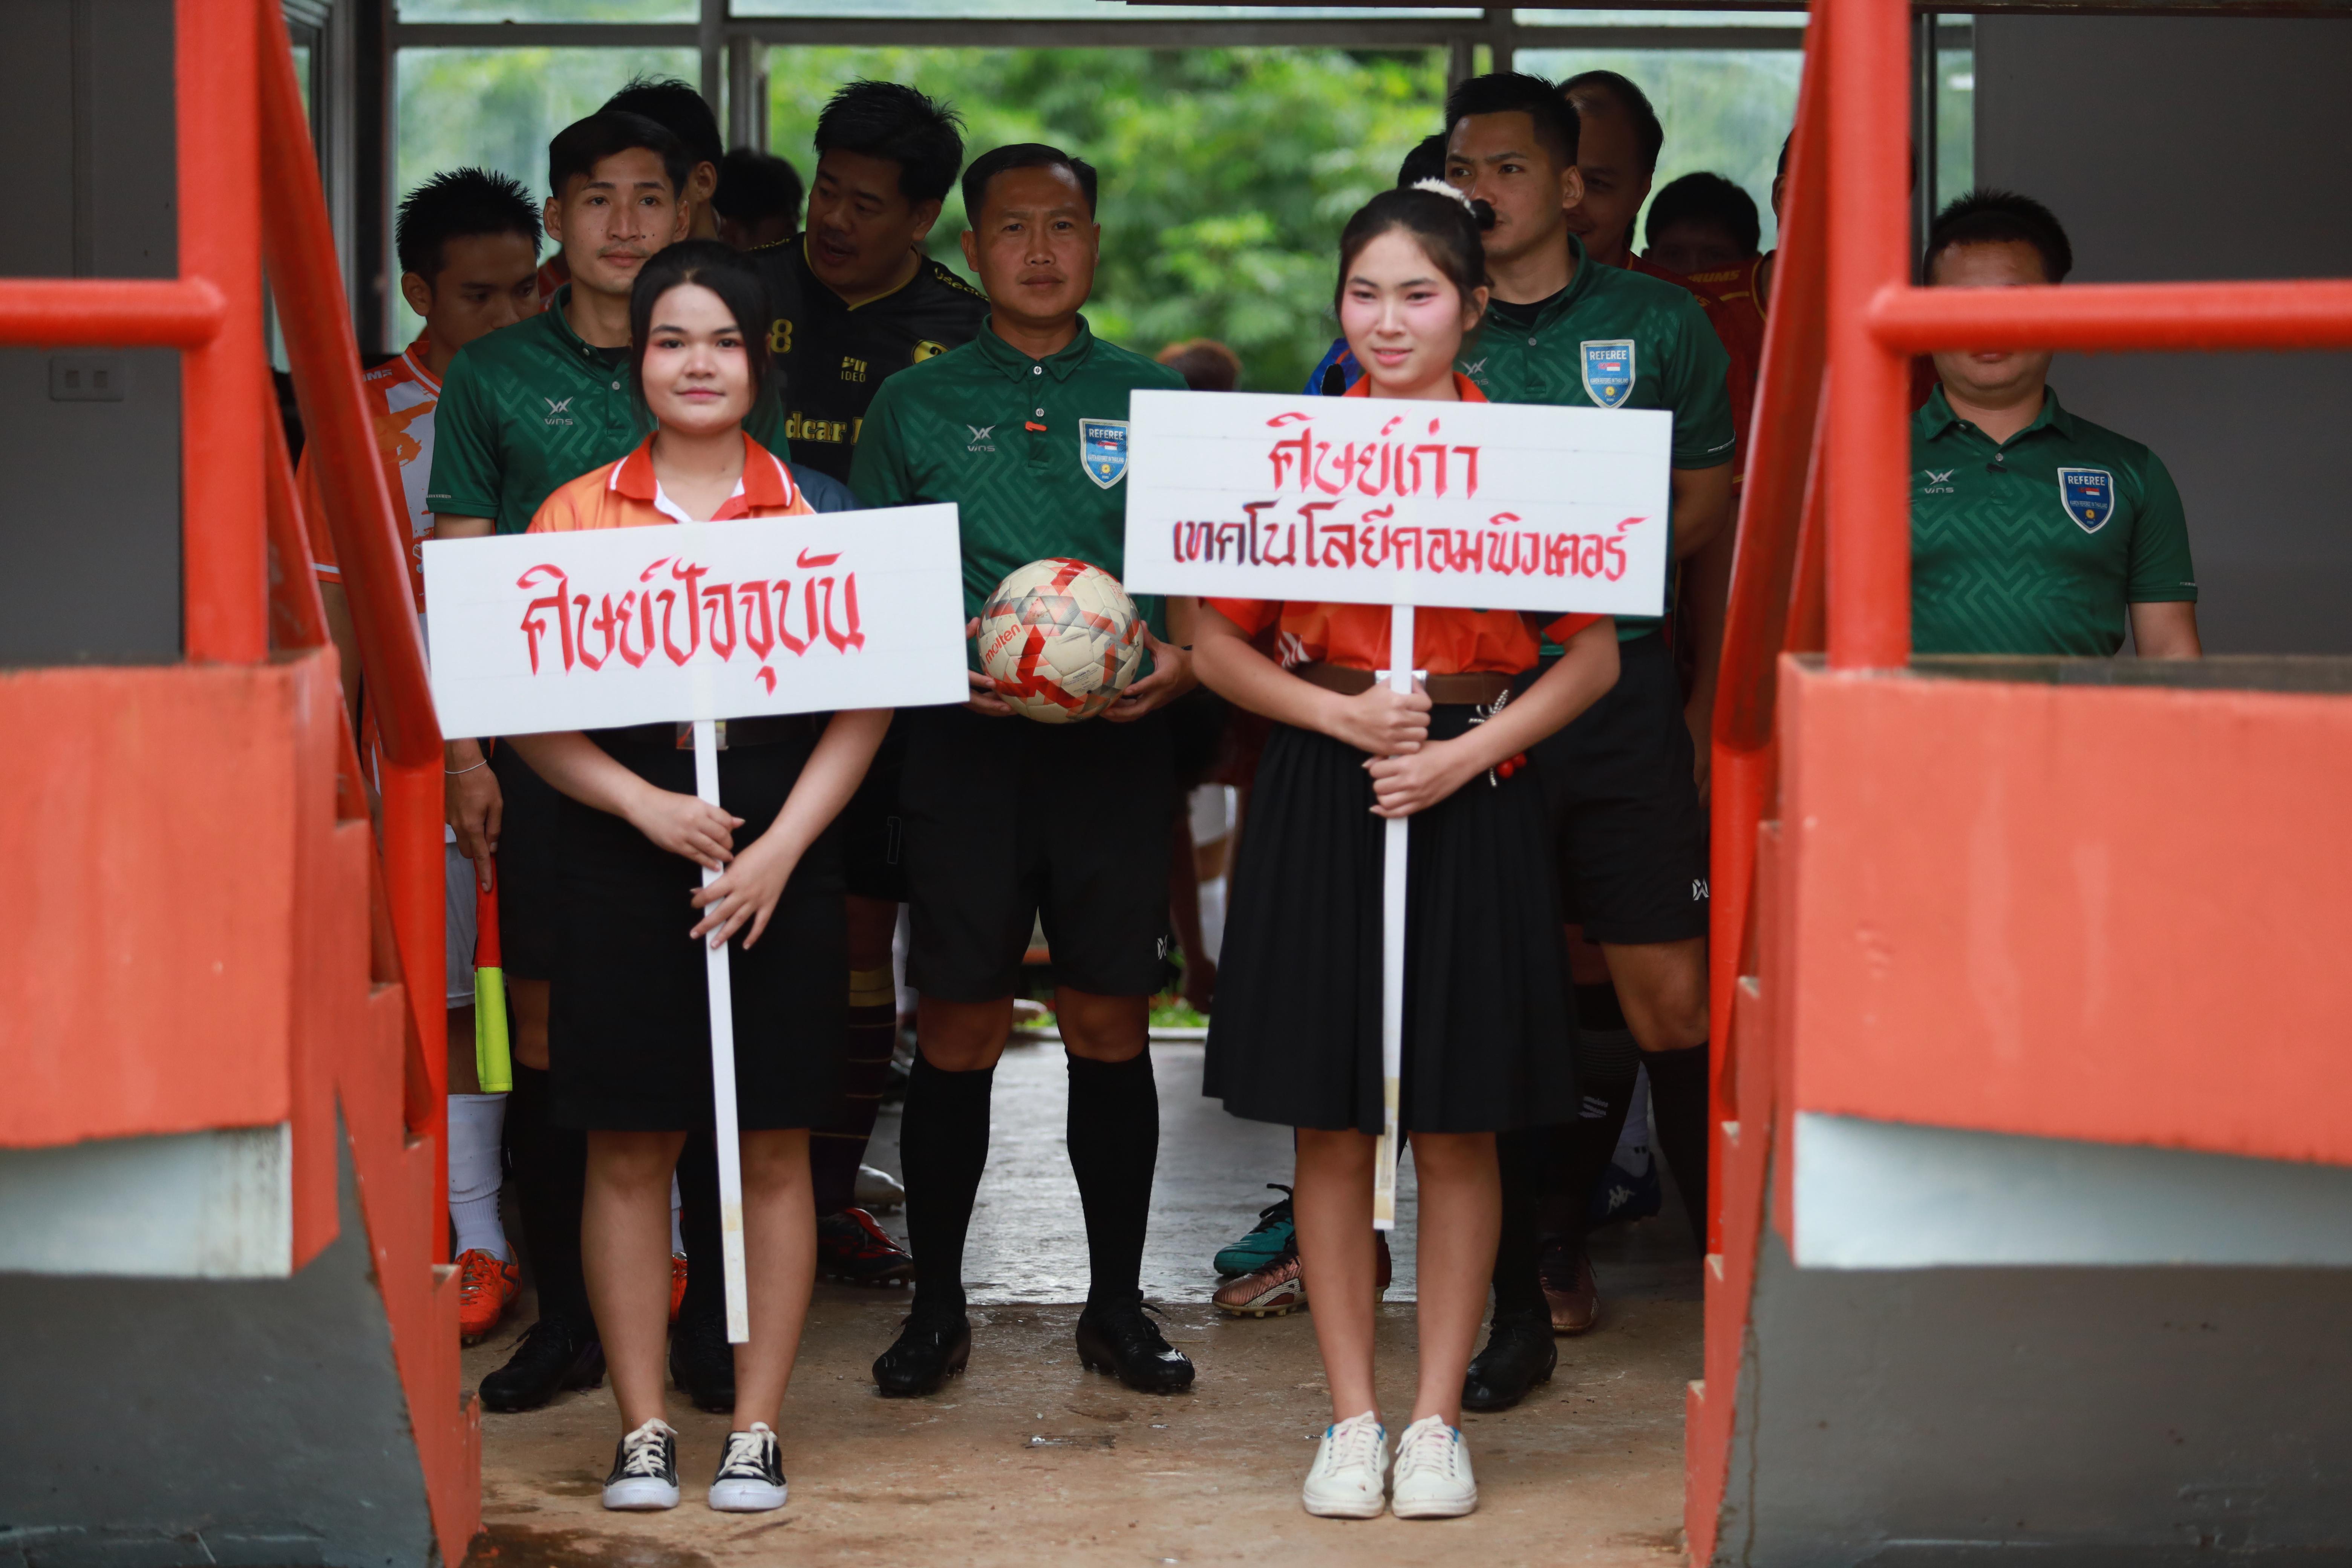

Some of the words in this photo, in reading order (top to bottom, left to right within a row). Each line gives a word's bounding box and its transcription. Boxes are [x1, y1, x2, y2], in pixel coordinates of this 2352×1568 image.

[1589, 350, 1627, 360] REFEREE
[841, 371, 866, 382] IDEO
[785, 411, 847, 444] dcar
[1089, 428, 1124, 440] REFEREE
[1266, 408, 1482, 500] ศิษย์เก่า
[2068, 475, 2105, 486] REFEREE
[1173, 497, 1653, 582] เทคโนโลยีคอมพิวเตอร์
[516, 547, 865, 697] ศิษย์ปัจจุบัน
[985, 624, 1021, 665] molten
